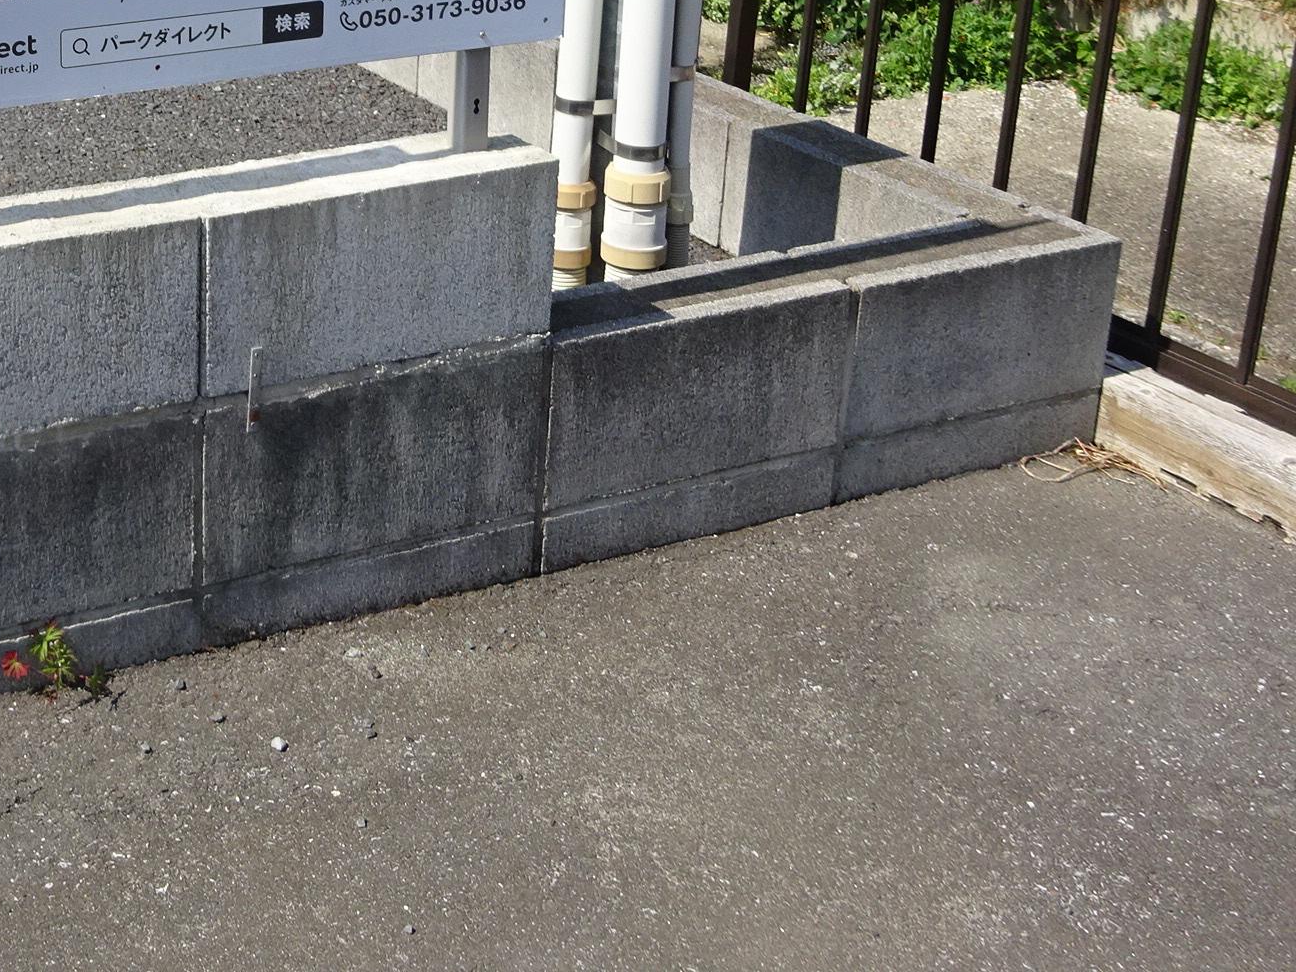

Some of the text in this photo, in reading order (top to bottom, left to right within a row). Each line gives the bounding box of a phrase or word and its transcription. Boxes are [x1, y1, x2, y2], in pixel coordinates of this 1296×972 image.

[275, 12, 311, 32] 検索
[100, 22, 231, 52] パークダイレクト
